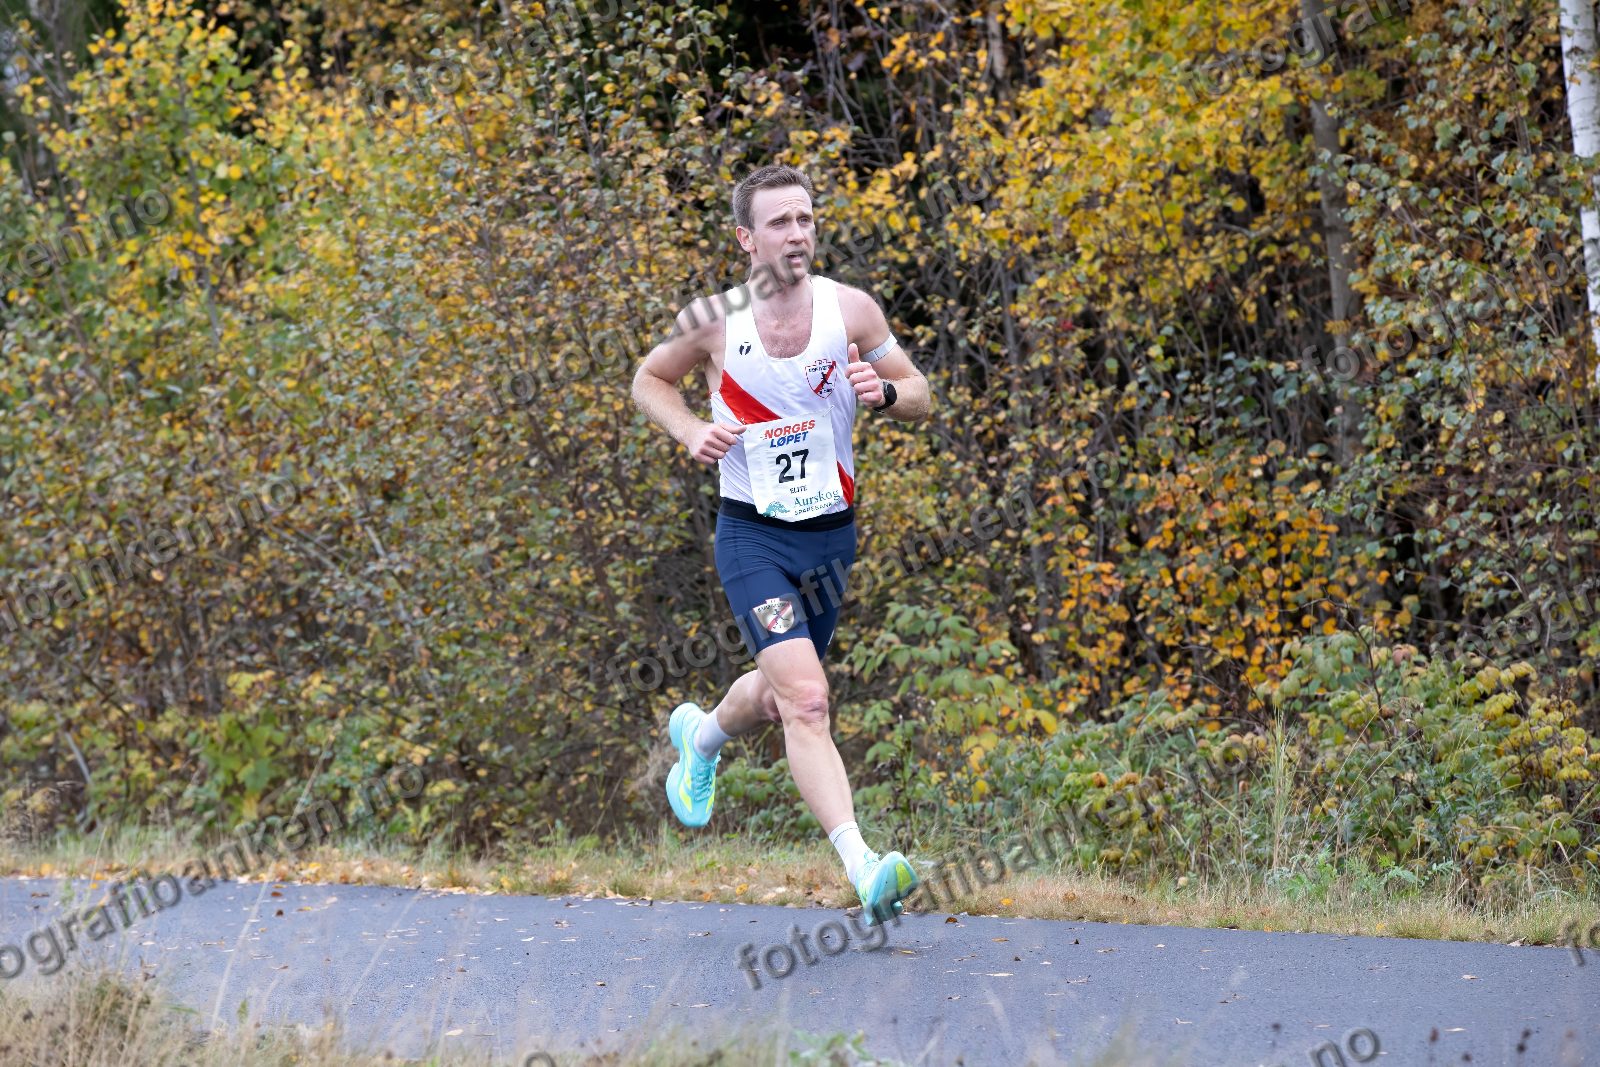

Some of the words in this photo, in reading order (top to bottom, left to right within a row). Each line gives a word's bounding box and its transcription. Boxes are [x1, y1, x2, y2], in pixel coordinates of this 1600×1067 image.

[764, 419, 816, 440] NORGES
[769, 430, 809, 449] LØPET
[775, 448, 809, 484] 27
[794, 489, 841, 507] Aurskog
